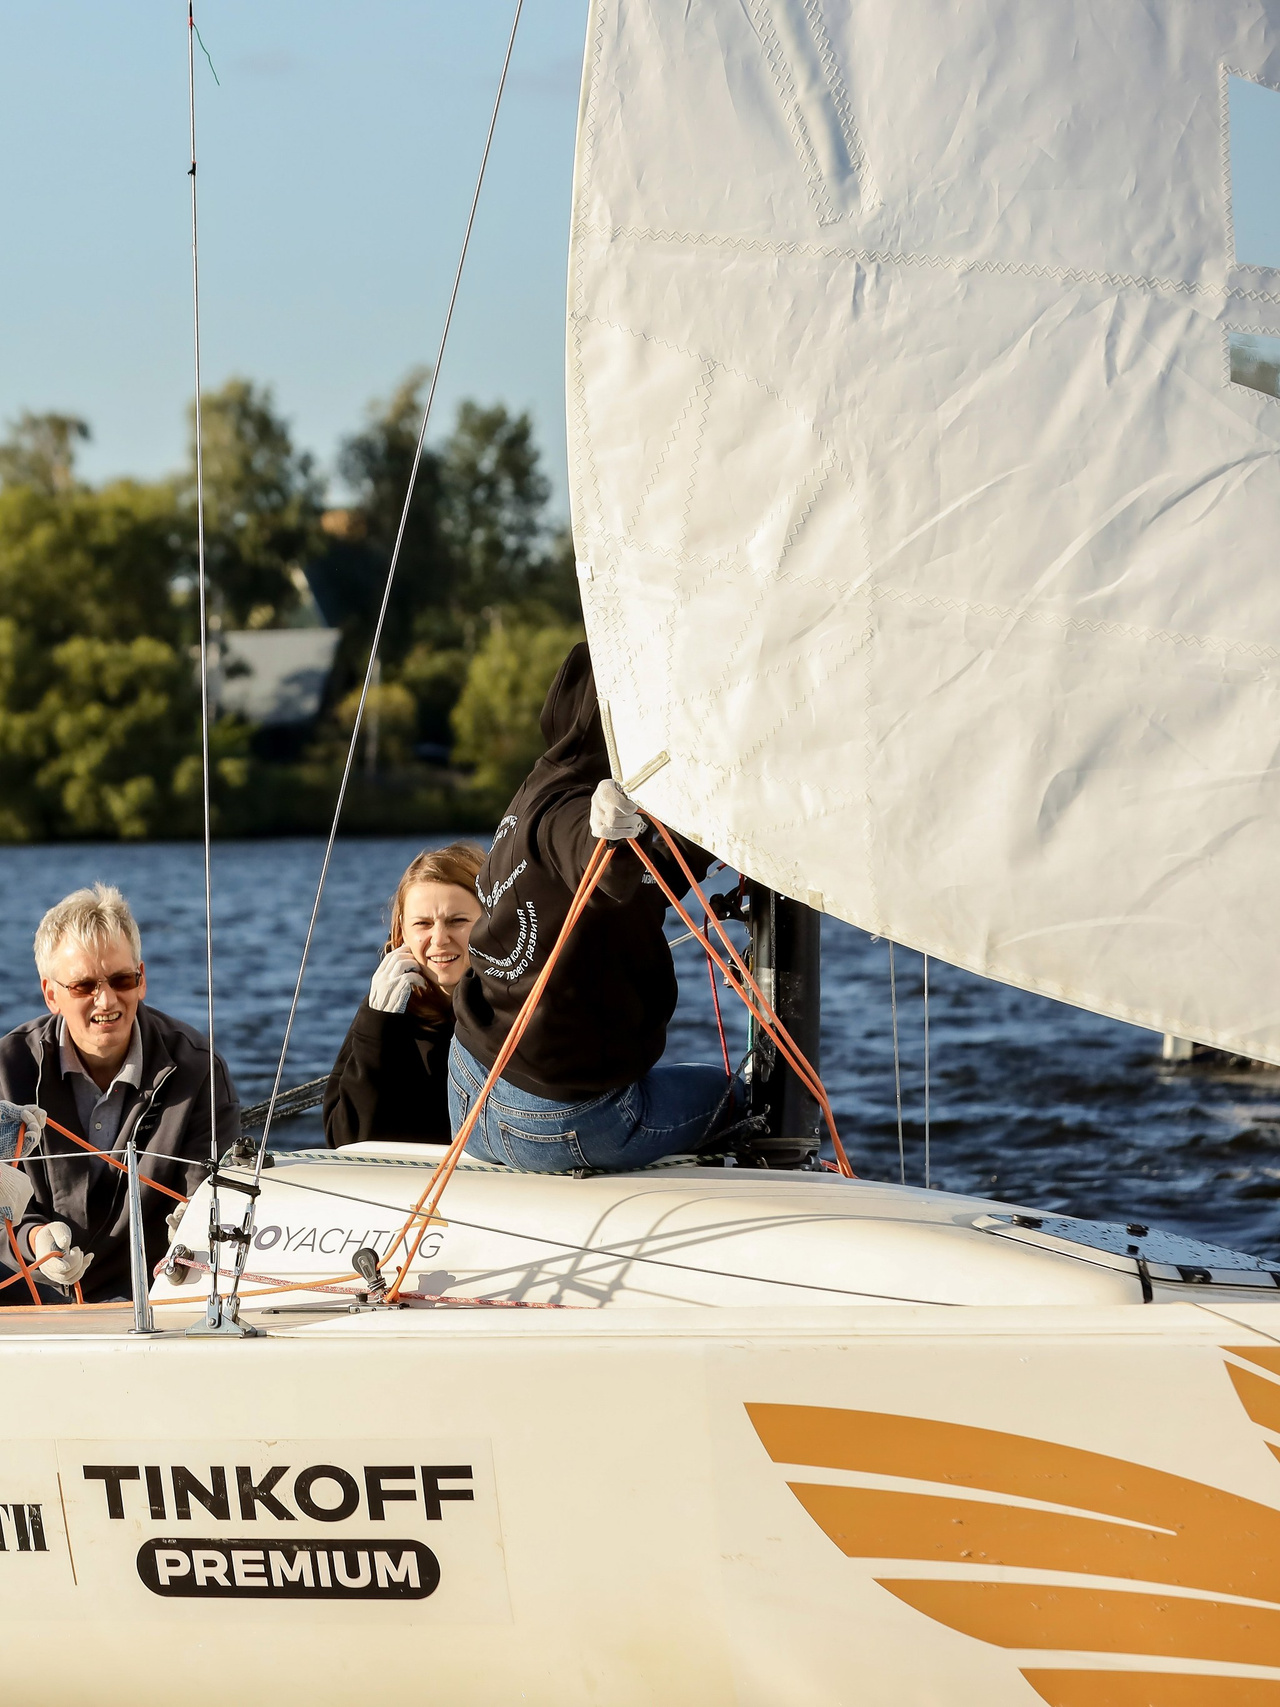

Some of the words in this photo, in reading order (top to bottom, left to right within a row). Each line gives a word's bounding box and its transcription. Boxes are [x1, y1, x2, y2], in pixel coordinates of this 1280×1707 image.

[484, 967, 505, 978] для
[506, 958, 529, 980] твоего
[525, 901, 538, 961] развития
[510, 908, 527, 962] компания
[82, 1464, 475, 1522] TINKOFF
[156, 1549, 423, 1589] PREMIUM
